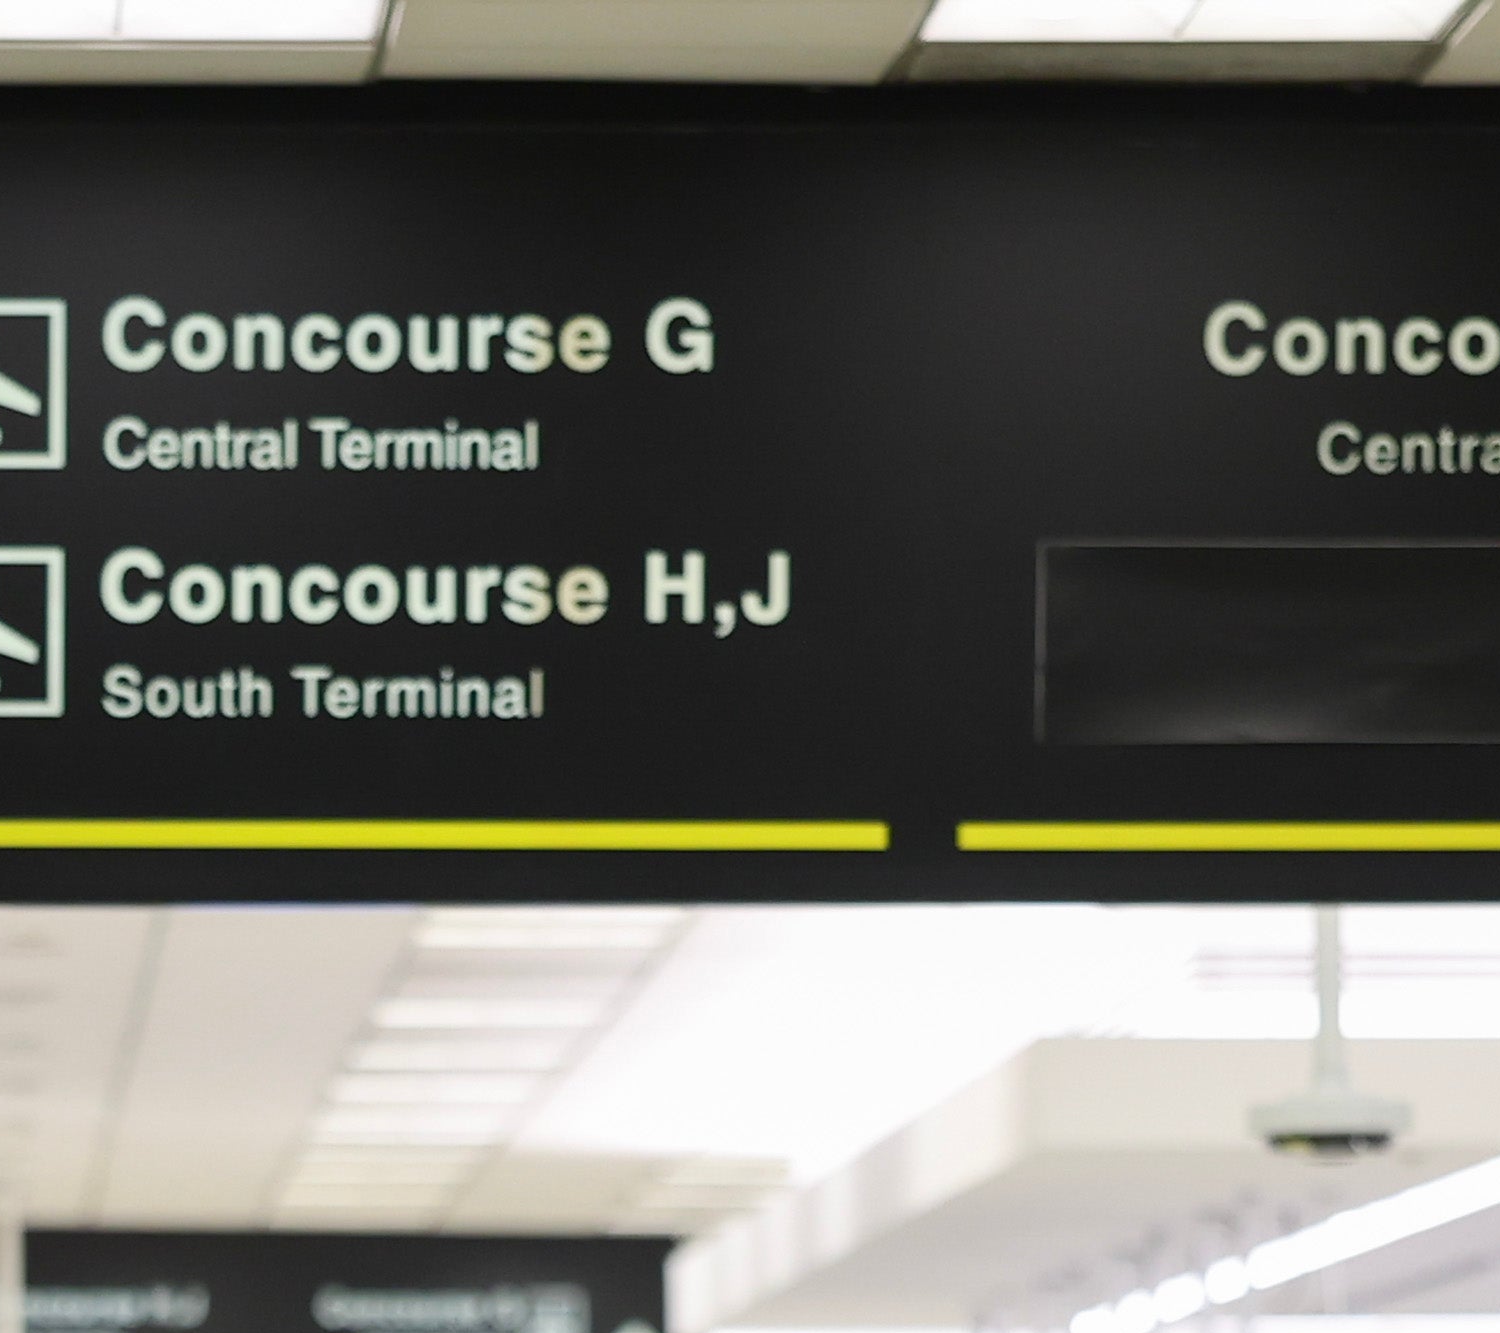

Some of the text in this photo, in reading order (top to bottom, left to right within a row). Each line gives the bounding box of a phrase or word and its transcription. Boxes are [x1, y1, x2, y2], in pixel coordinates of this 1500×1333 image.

[100, 294, 715, 374] Concourse G
[101, 414, 540, 471] Central Terminal
[98, 546, 792, 640] Concourse H,J
[100, 664, 545, 720] South Terminal
